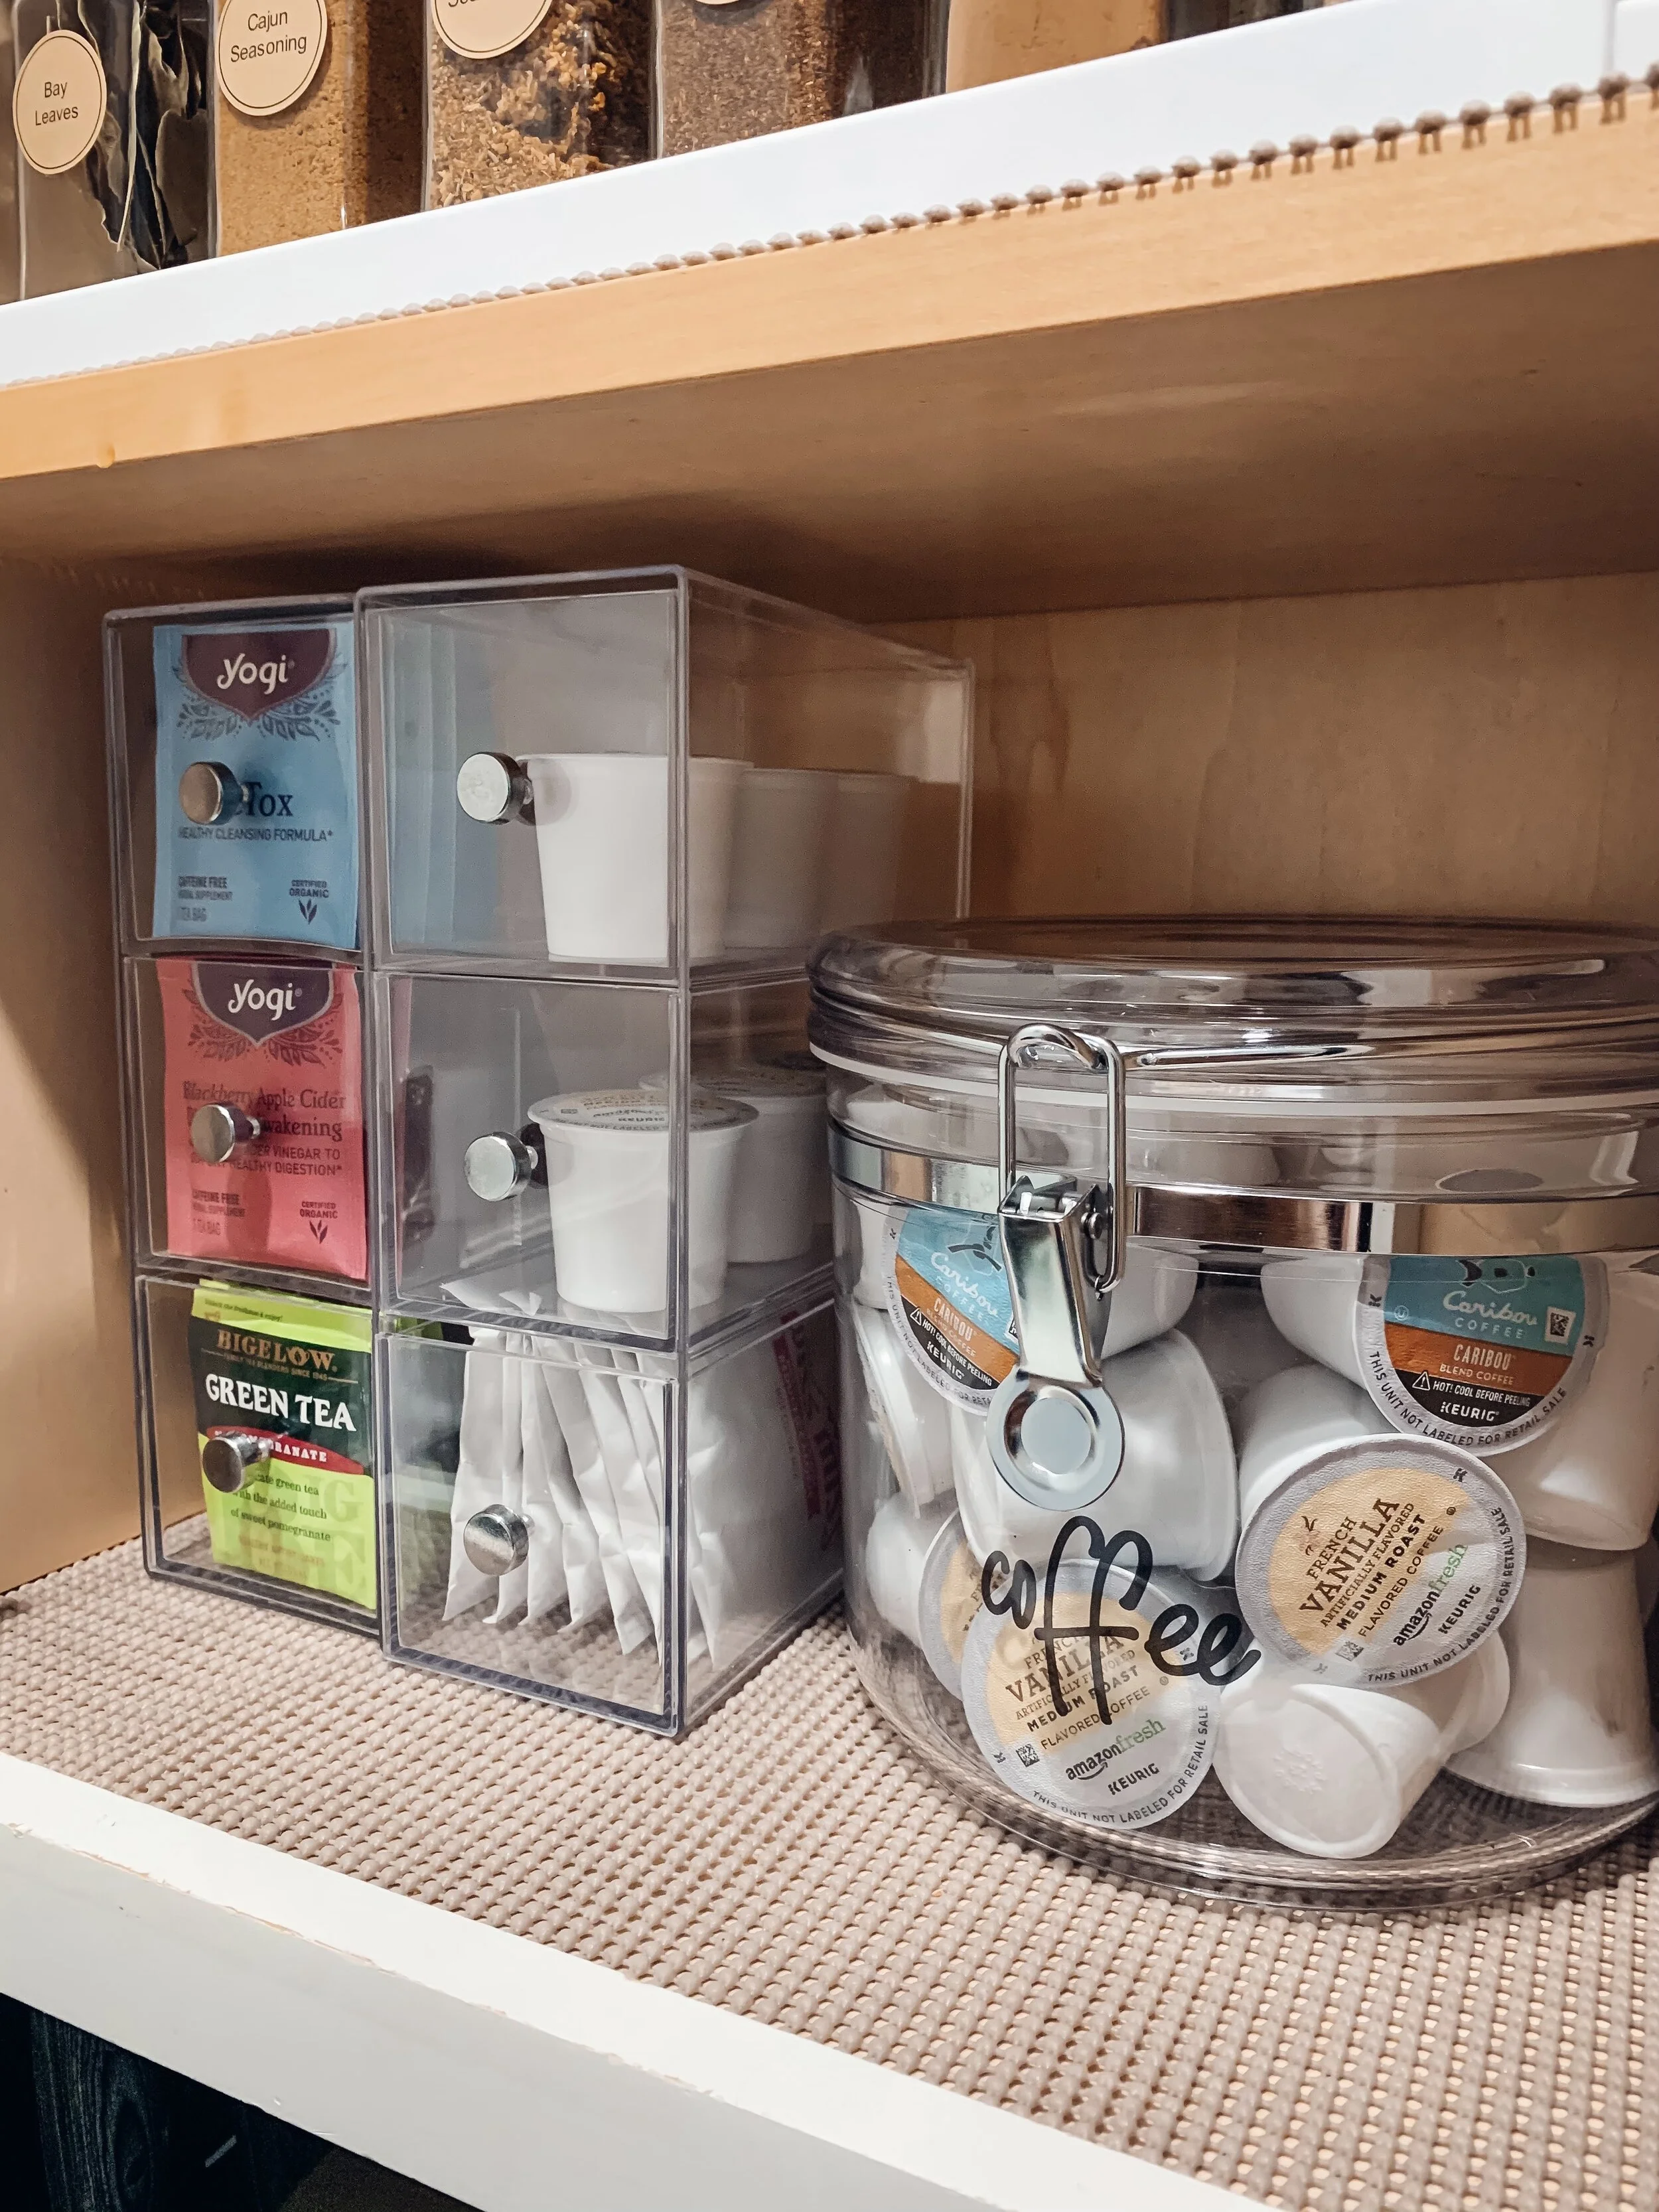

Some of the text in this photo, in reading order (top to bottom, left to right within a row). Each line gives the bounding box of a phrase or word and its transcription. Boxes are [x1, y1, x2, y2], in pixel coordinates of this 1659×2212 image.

[248, 11, 288, 33] Cajun
[230, 35, 307, 62] Seasoning
[44, 82, 68, 99] Bay
[35, 106, 78, 126] Leaves
[215, 828, 271, 842] CLEANSING
[289, 887, 329, 899] ORGANIC
[256, 1086, 295, 1111] Apple
[300, 1089, 346, 1110] Cider
[260, 1114, 343, 1142] wakening
[271, 1145, 321, 1160] VINEGAR
[325, 1147, 340, 1160] TO
[299, 1209, 338, 1219] ORGANIC
[931, 1252, 998, 1317] Caribou
[926, 1308, 947, 1331] BLEND
[934, 1297, 974, 1342] CARIBOU
[1443, 1290, 1538, 1325] Caribou
[1455, 1317, 1524, 1339] COFFEE
[217, 1329, 335, 1372] BIGELOW
[922, 1319, 992, 1386] HOT! COOL BEFORE PEELING
[926, 1341, 962, 1380] KEURIG
[1453, 1344, 1512, 1370] CARIBOU
[1439, 1364, 1514, 1385] BLEND COFFEE
[206, 1374, 357, 1432] GREEN TEA
[972, 1396, 991, 1406] RETA
[1370, 1351, 1567, 1446] THIS UNIT NOT LABELED FOR RETAIL SALE
[1433, 1380, 1531, 1408] HOT! COOL BEFORE PEELING
[1440, 1401, 1496, 1422] KEURIG
[275, 1478, 302, 1493] green
[304, 1484, 319, 1496] tea
[253, 1492, 268, 1505] the
[269, 1497, 297, 1513] added
[299, 1505, 327, 1519] touch
[230, 1507, 331, 1541] of sweet pomegranate
[1490, 1507, 1510, 1535] SALE
[1299, 1498, 1400, 1611] VANILLA
[1306, 1516, 1357, 1580] FRENCH
[1502, 1535, 1515, 1577] RETAIL
[1320, 1503, 1415, 1627] ARTIFICIALLY FLAVORED
[1336, 1514, 1425, 1631] MEDIUM ROAST
[1358, 1526, 1444, 1637] FLAVORED COFFEE
[1496, 1580, 1512, 1603] FOR
[981, 1515, 1262, 1726] coffee
[1438, 1584, 1481, 1635] KEURIG
[1006, 1635, 1124, 1702] VAILA
[1400, 1662, 1429, 1678] UNIT
[1433, 1649, 1457, 1666] NOT
[1368, 1672, 1396, 1682] THIS
[1015, 1677, 1082, 1720] ARTIFICLLY
[1027, 1695, 1086, 1732] MEDUM
[1041, 1686, 1151, 1750] FLAVORED OFFEE
[1033, 1705, 1208, 1824] THIS UNIT NOT LABELED FOR RETAIL SALE
[1108, 1763, 1160, 1795] KEURIG
